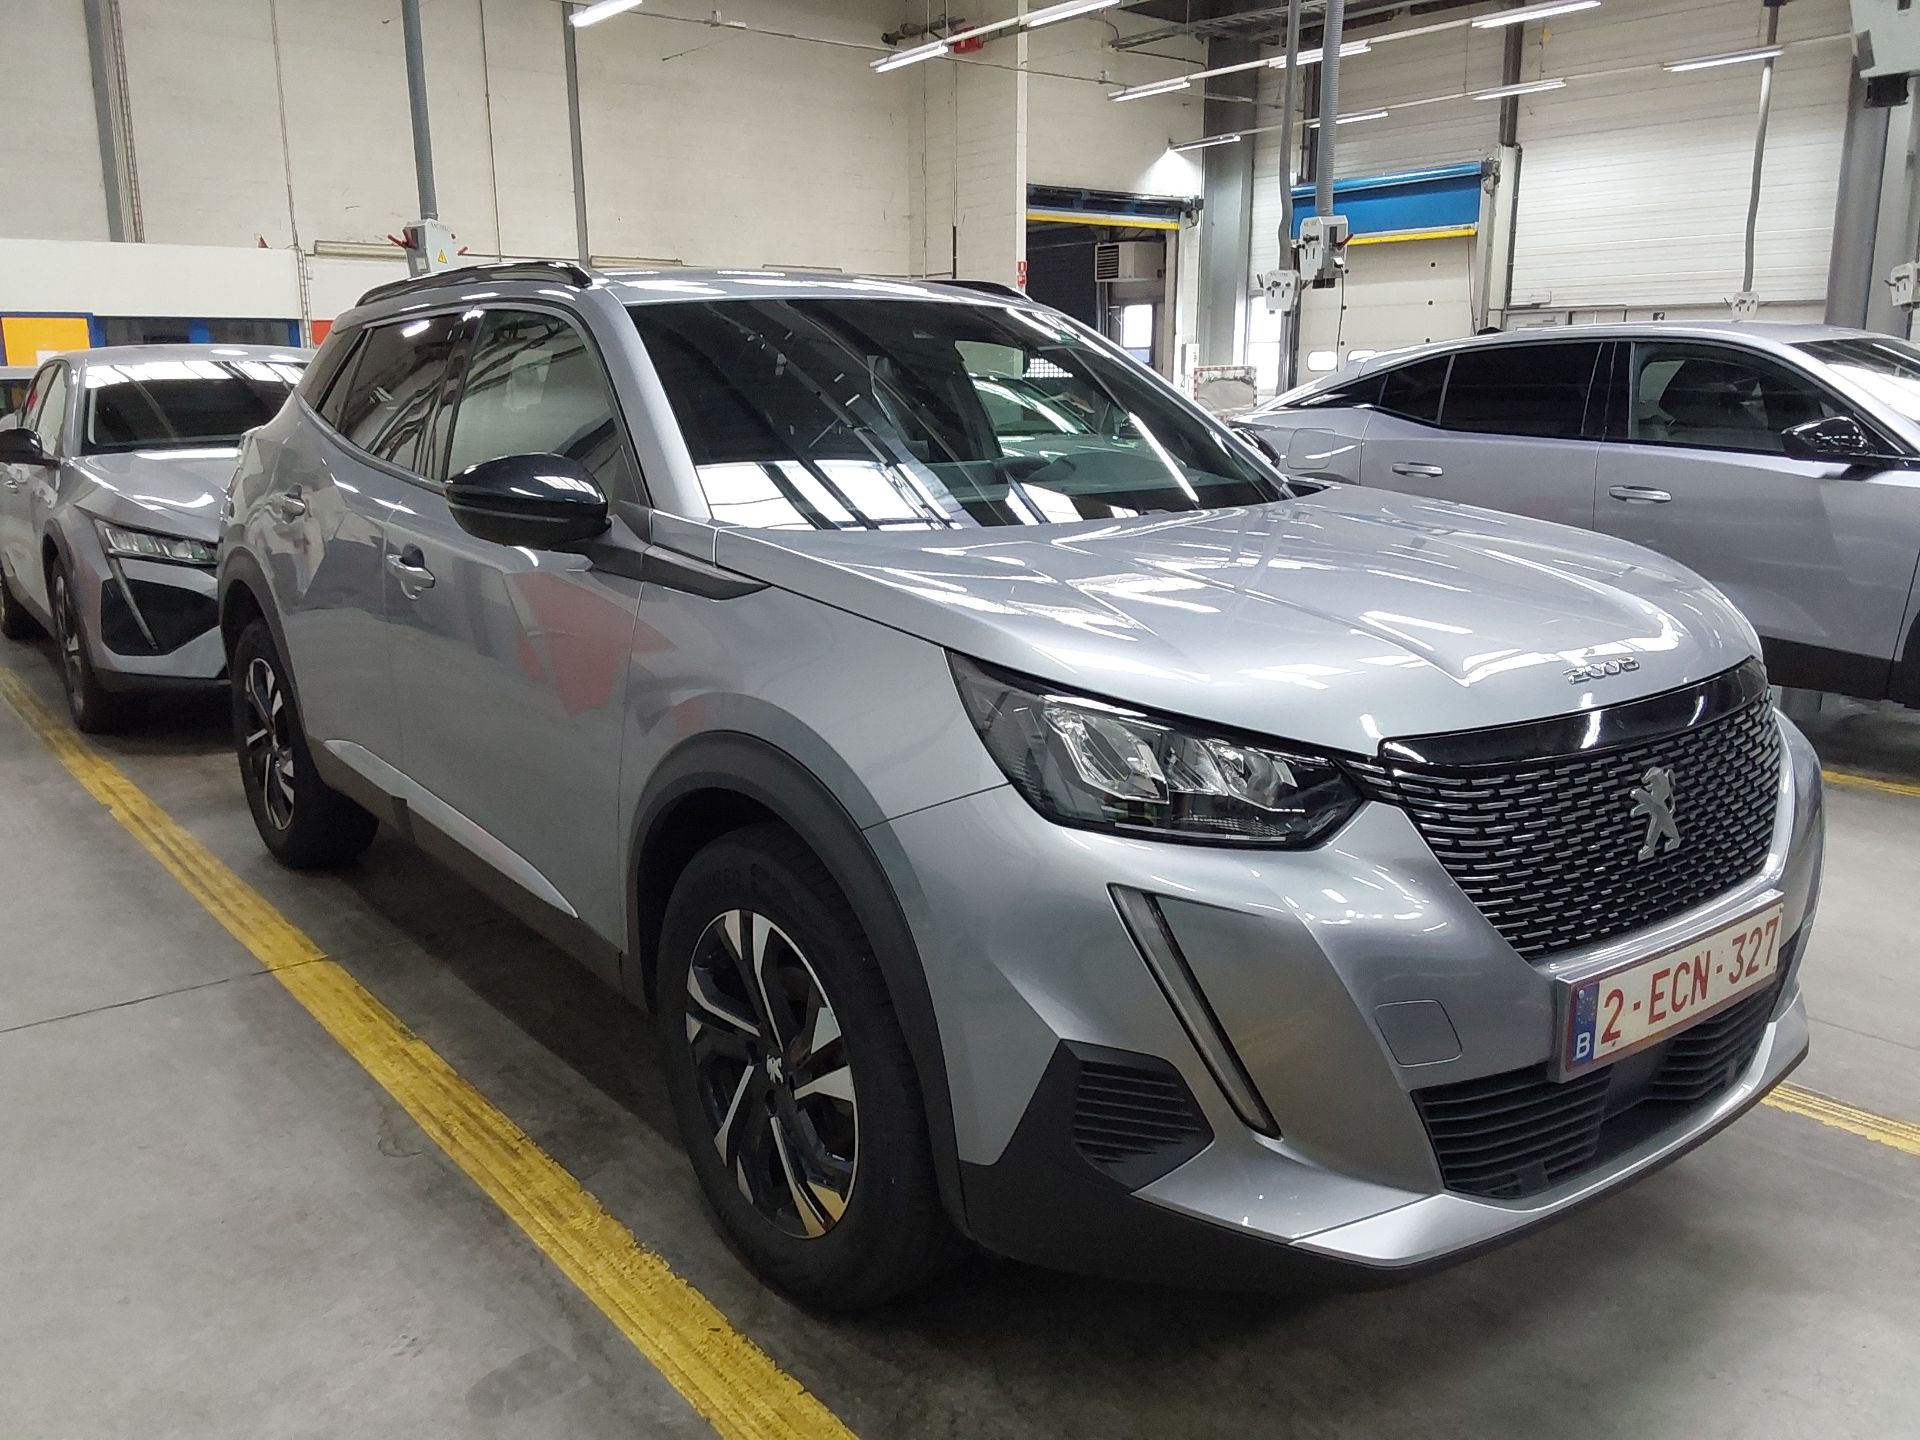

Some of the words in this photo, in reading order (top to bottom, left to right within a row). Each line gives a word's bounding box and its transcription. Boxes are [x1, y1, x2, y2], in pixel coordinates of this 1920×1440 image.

[1563, 657, 1639, 684] 2008
[1601, 915, 1780, 1044] 2-ECN-327
[1576, 1032, 1591, 1059] B
